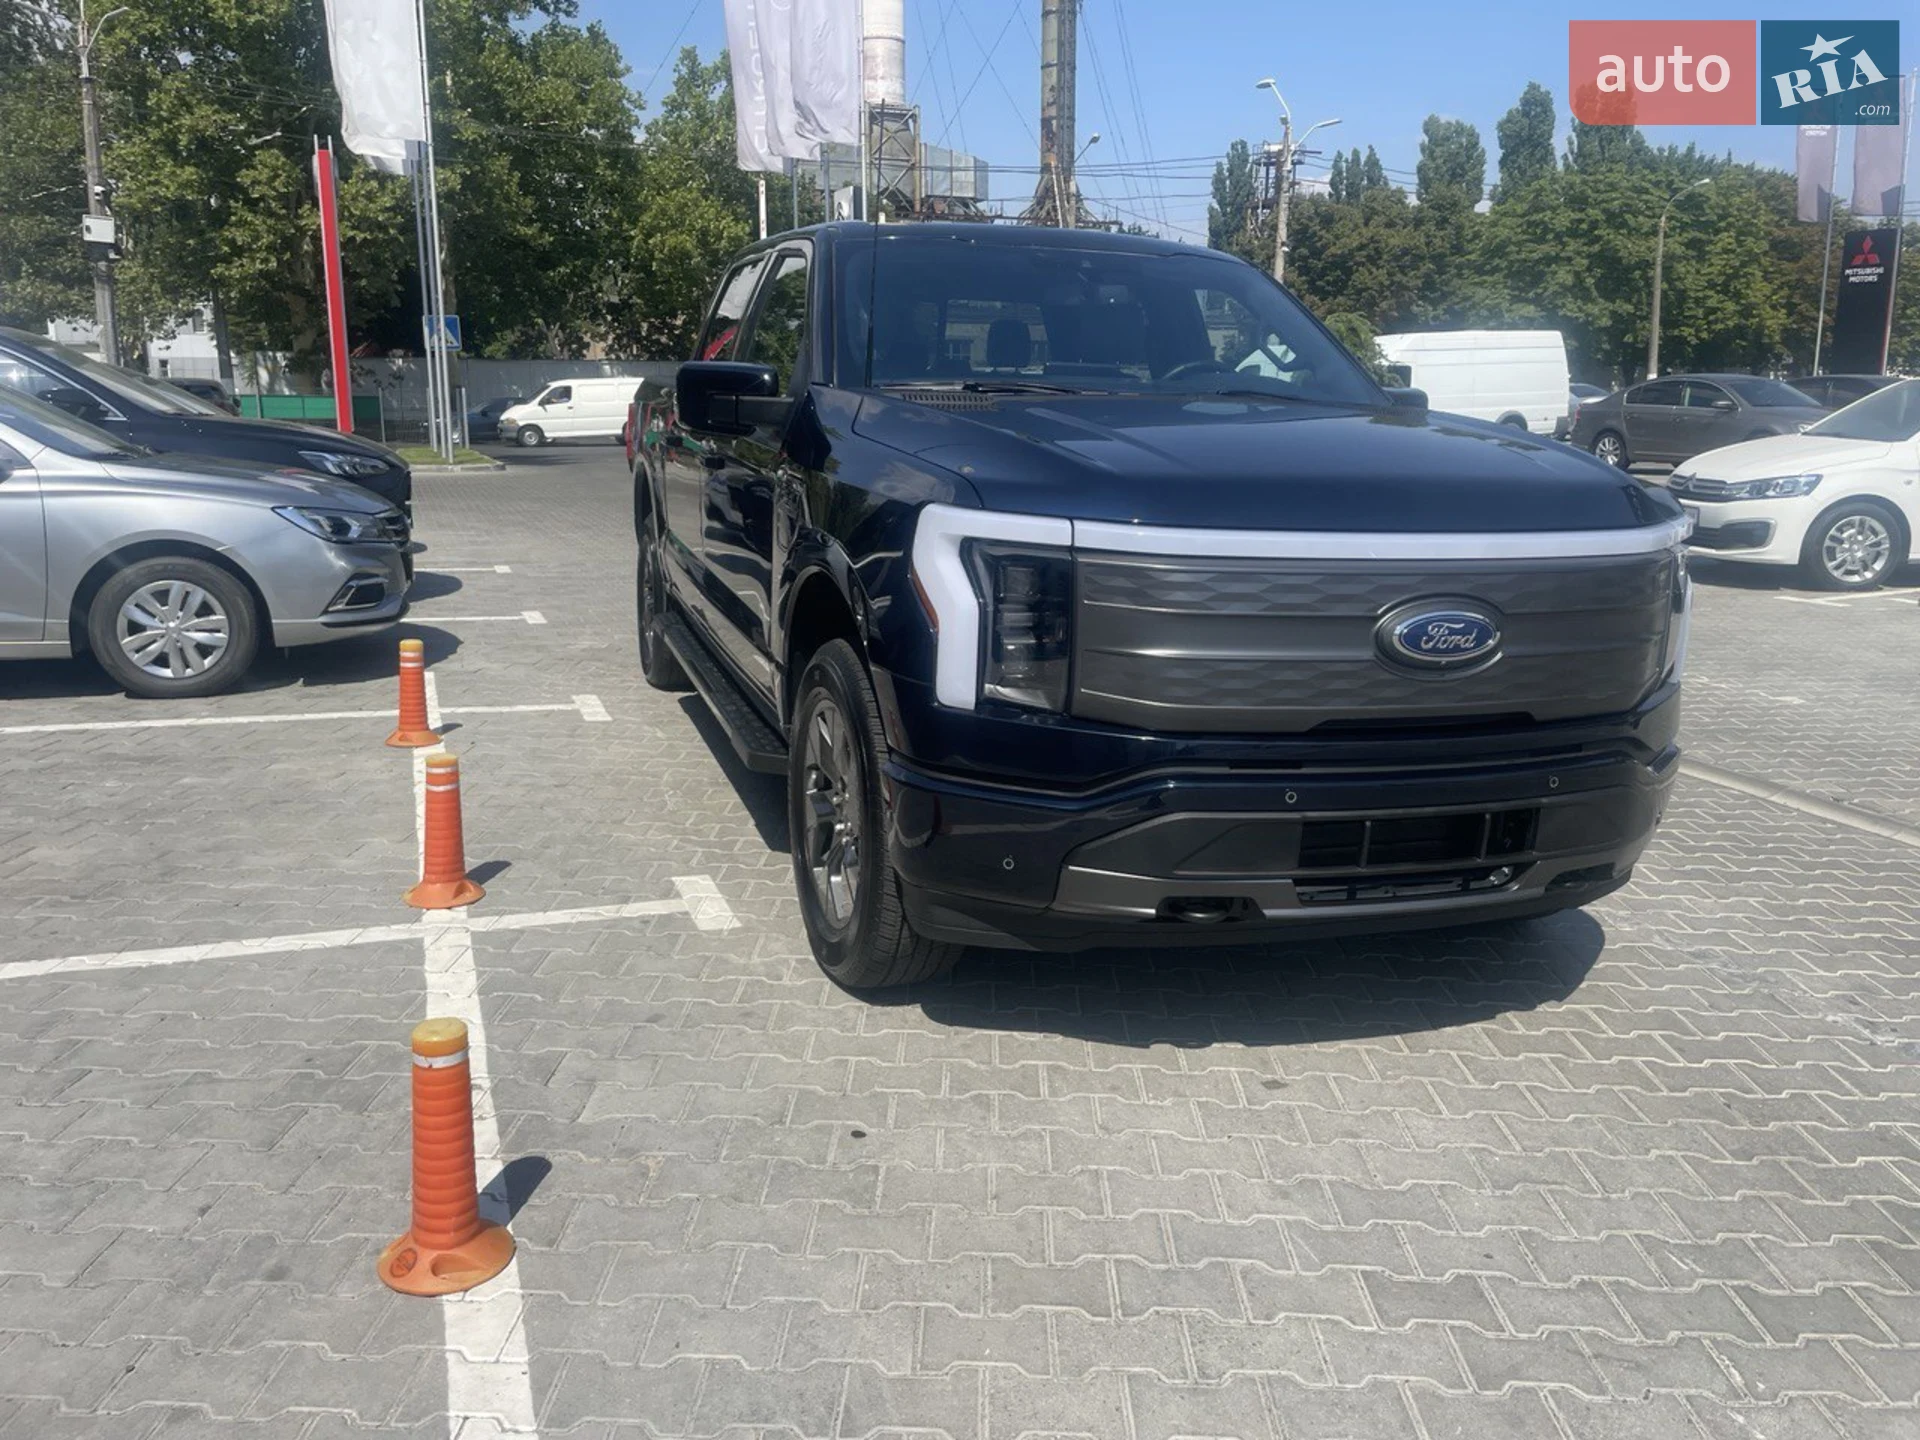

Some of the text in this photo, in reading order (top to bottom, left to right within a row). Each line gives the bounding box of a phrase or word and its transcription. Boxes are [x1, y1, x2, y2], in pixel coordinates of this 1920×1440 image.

[1844, 267, 1885, 276] MITSUBISHI
[1848, 275, 1878, 283] MOTORS
[1421, 621, 1478, 649] Ford
